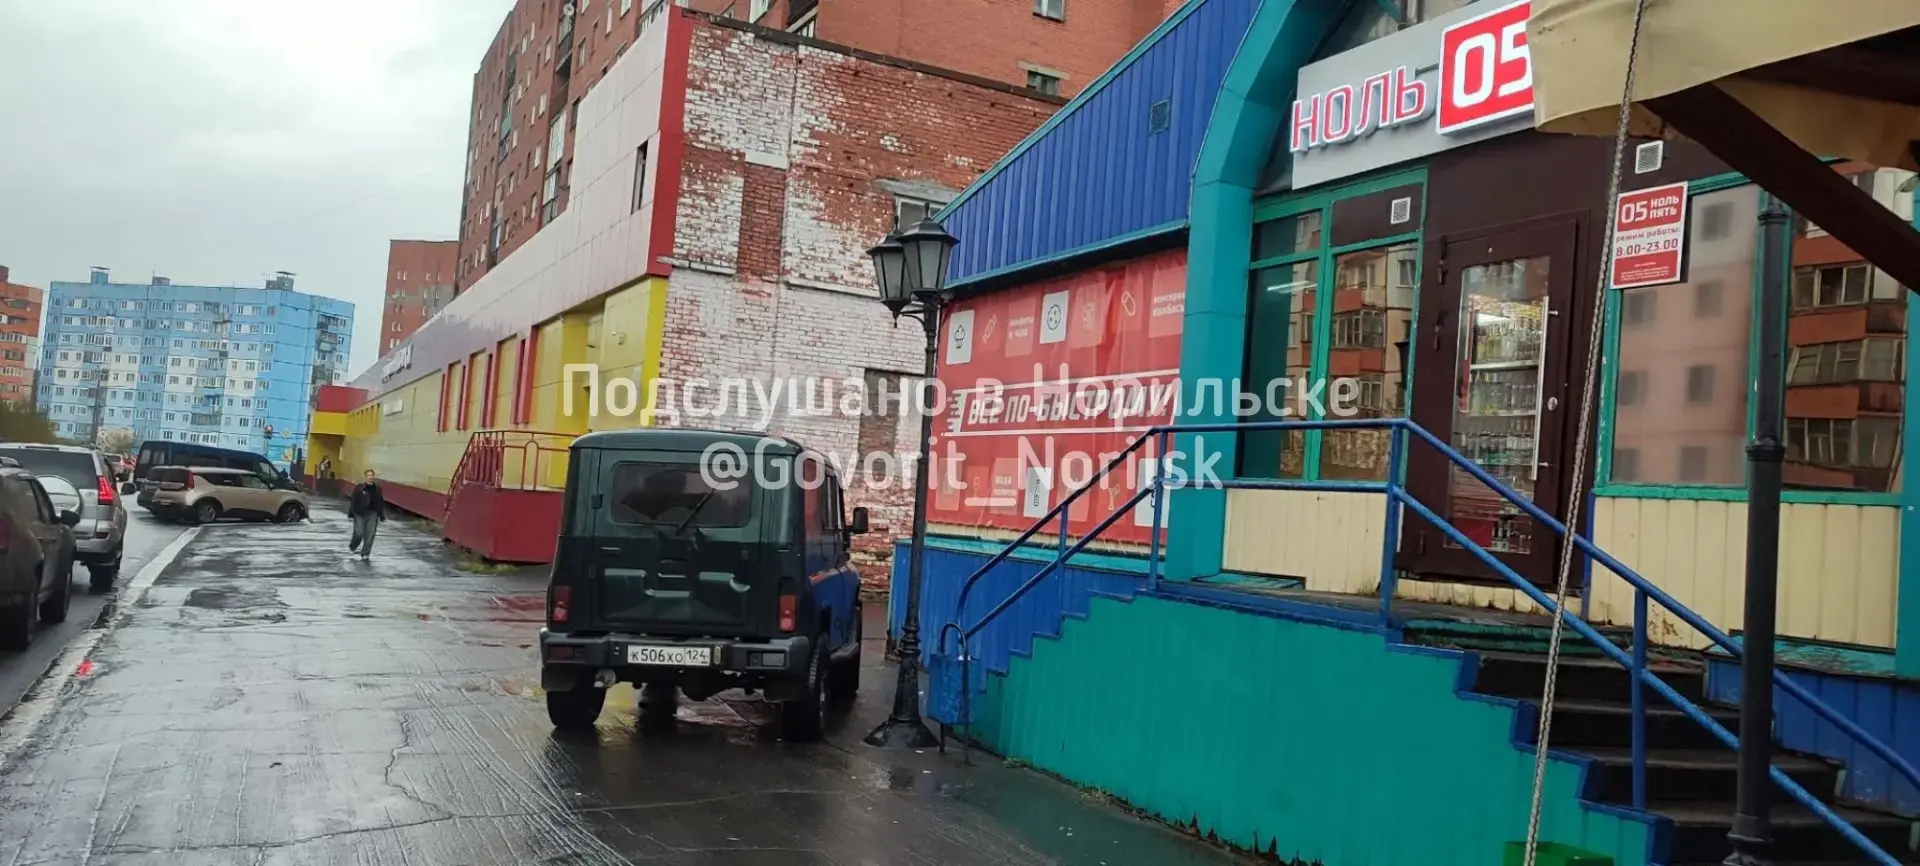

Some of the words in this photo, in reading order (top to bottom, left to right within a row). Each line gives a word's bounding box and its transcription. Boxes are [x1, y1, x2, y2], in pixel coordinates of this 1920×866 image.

[1290, 65, 1427, 152] НОЛЬ
[1453, 20, 1532, 109] 05
[1650, 195, 1680, 208] НОЛЬ
[1621, 201, 1649, 223] 05
[1649, 206, 1677, 219] ПЯТЬ
[1616, 238, 1678, 257] 8.00-23.00
[686, 649, 706, 661] 124
